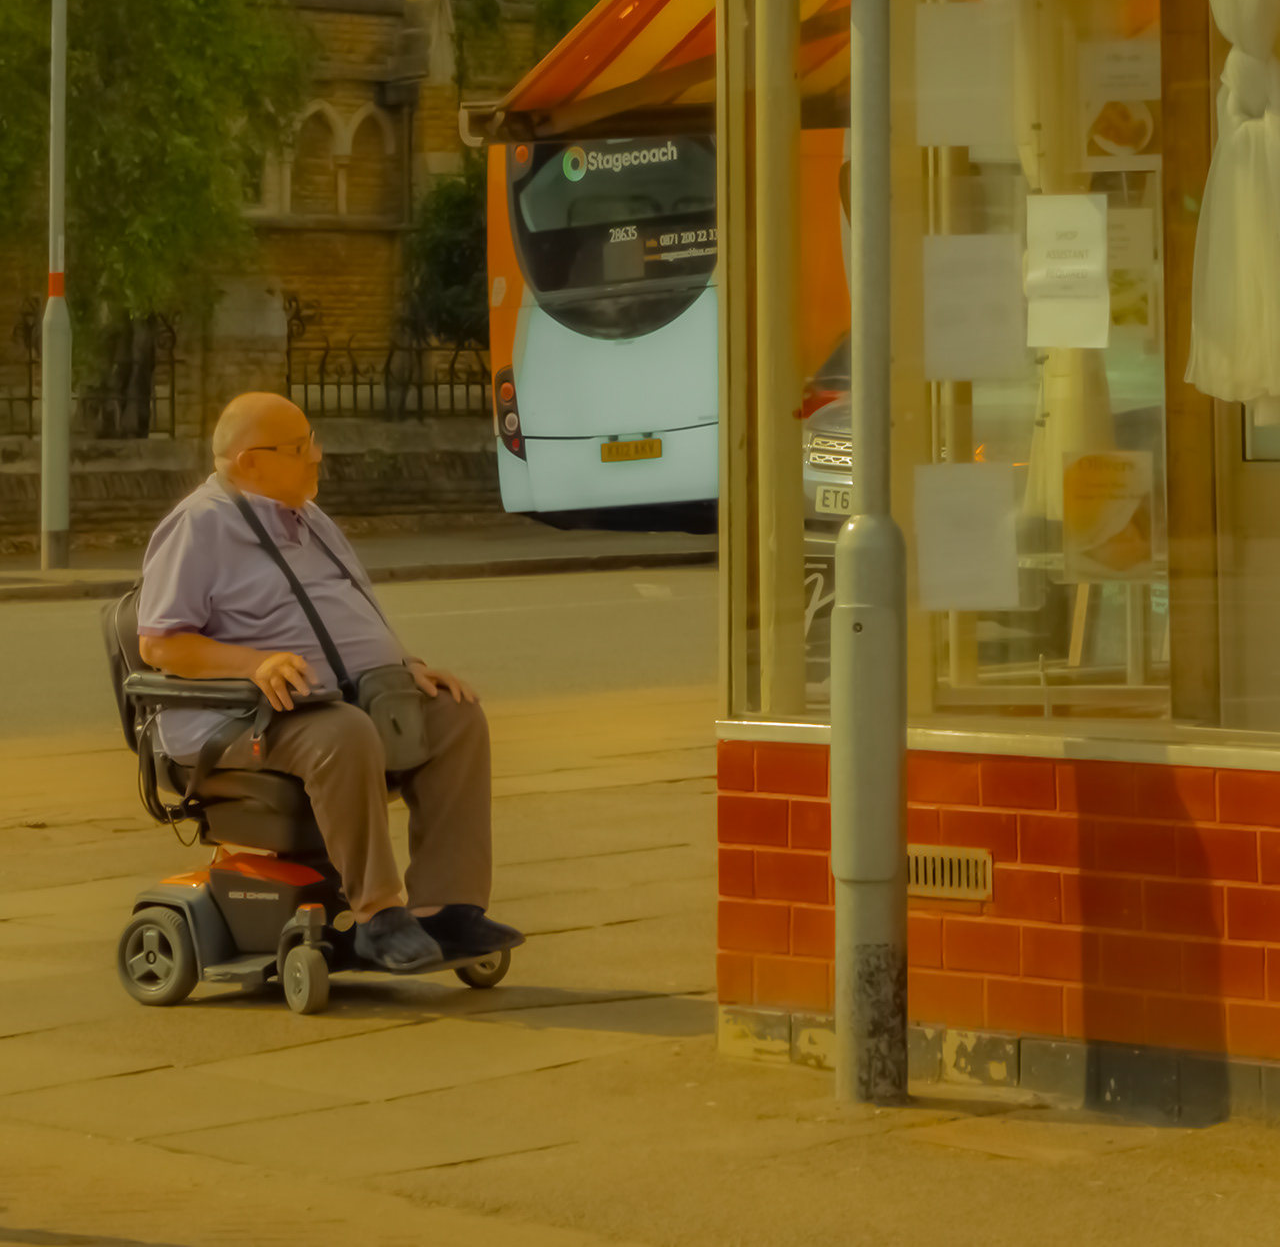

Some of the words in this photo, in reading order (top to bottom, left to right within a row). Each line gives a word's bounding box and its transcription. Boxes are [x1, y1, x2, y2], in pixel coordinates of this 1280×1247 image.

[587, 141, 677, 172] Stagecoach
[609, 225, 638, 243] 28635
[681, 231, 695, 244] 200
[697, 229, 707, 242] 22
[1055, 230, 1079, 241] SHOP
[1045, 249, 1089, 259] ASSISTANT
[822, 490, 850, 510] ET6
